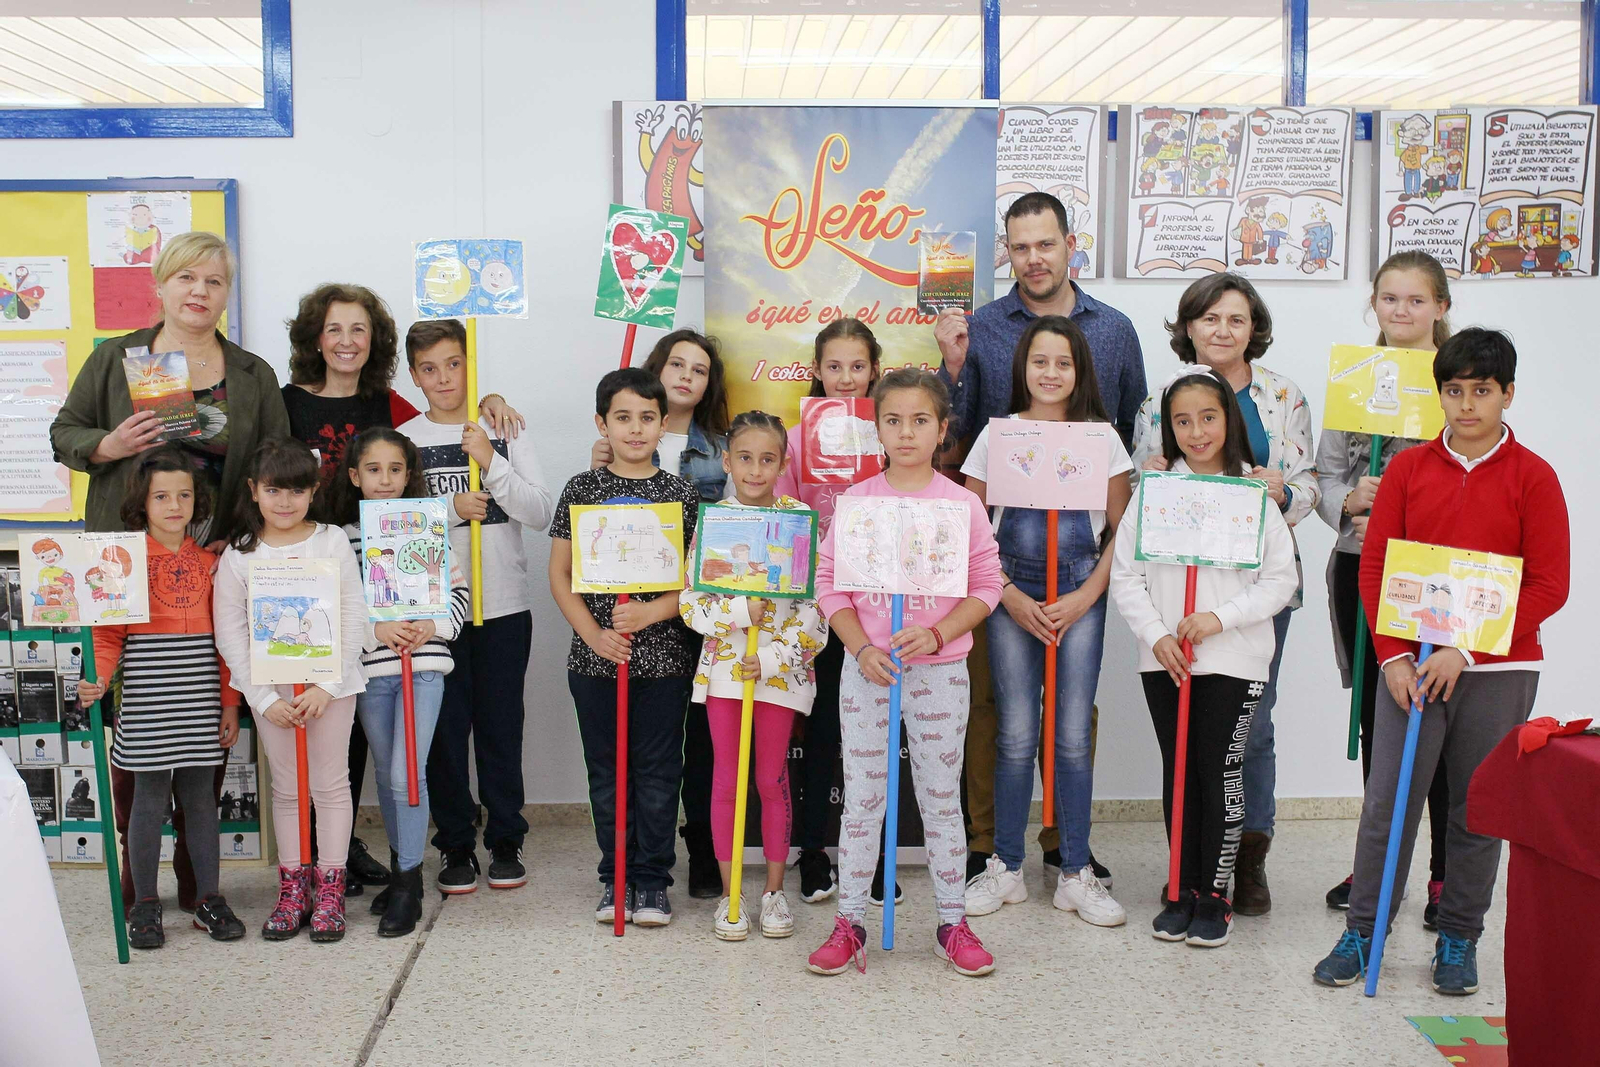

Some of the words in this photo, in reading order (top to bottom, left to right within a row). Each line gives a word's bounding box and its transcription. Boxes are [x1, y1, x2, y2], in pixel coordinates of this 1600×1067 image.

[1008, 118, 1043, 126] CUANDO
[1048, 118, 1079, 126] COJAS
[1510, 122, 1536, 132] UTILIZA
[1546, 122, 1586, 130] BIBLIOTECA
[1058, 165, 1083, 173] LUGAR
[1488, 167, 1512, 175] QUEDE
[1162, 214, 1198, 222] INFORMA
[1423, 218, 1444, 226] CASO
[1395, 239, 1425, 247] PROCURA
[855, 300, 880, 324] el
[768, 362, 812, 382] colec
[1224, 766, 1245, 822] THEM
